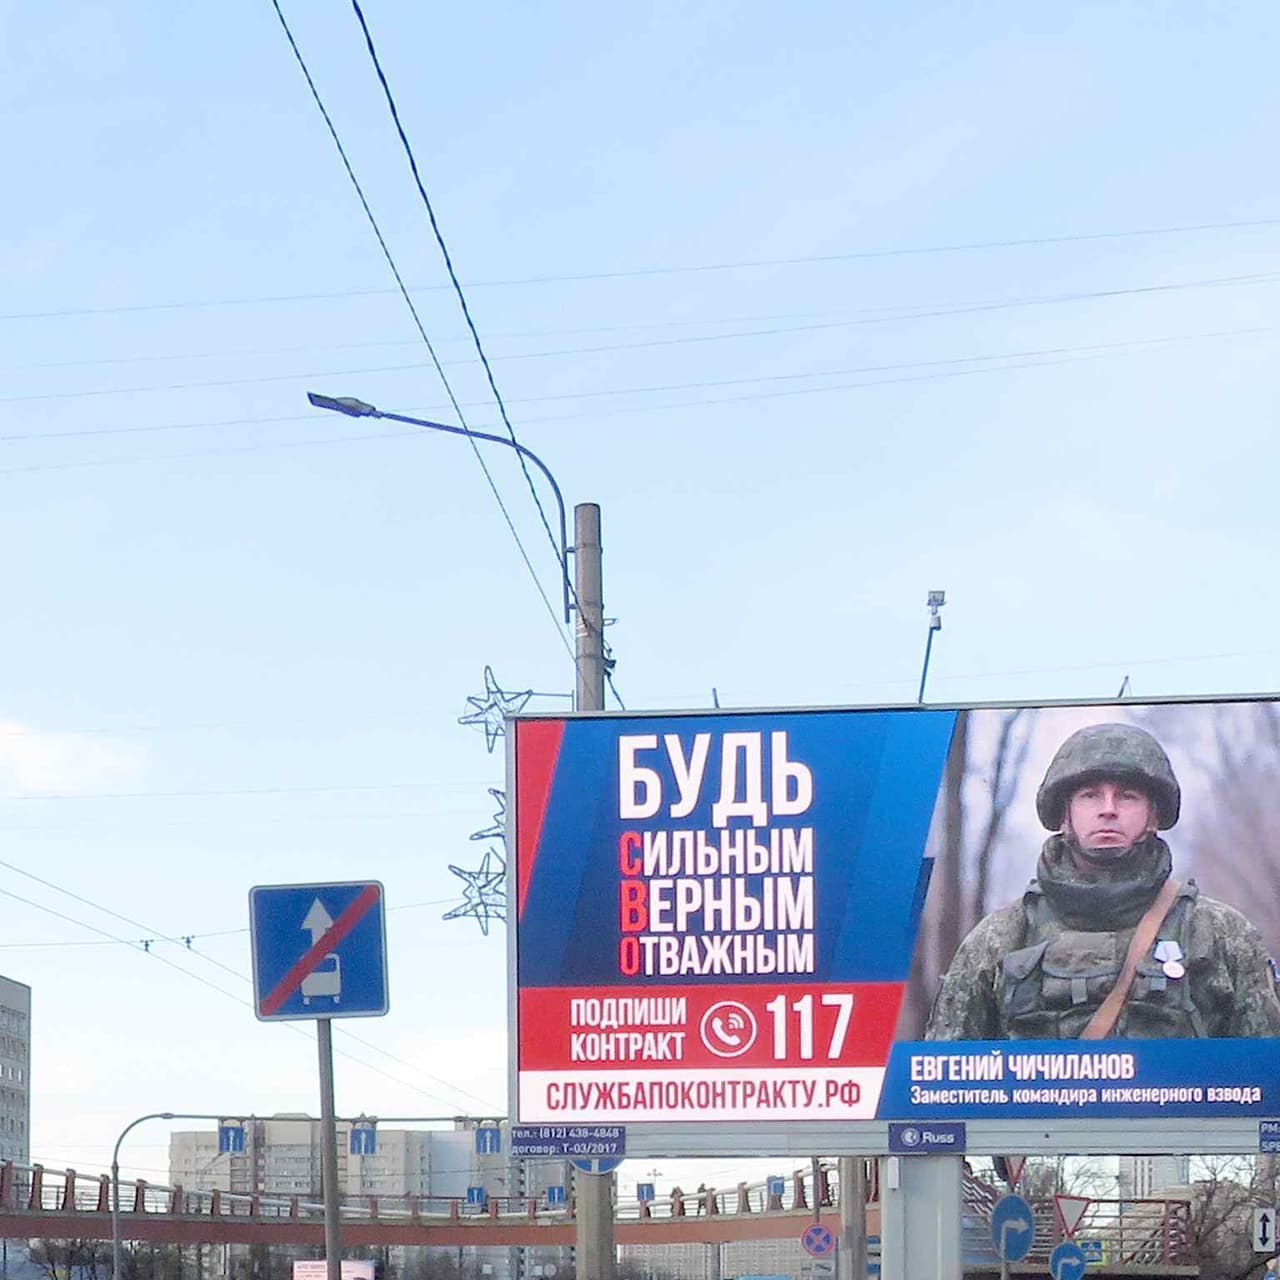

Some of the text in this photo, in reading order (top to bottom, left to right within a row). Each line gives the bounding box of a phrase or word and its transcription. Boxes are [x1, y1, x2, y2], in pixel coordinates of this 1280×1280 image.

[619, 731, 813, 828] БУДЬ
[620, 828, 813, 876] СИЛЬНЫМ
[621, 876, 814, 932] ВЕРНЫМ
[621, 934, 814, 975] ОТВАЖНЫМ
[572, 997, 687, 1028] ПОДПИШИ
[766, 994, 854, 1060] 117
[571, 1032, 686, 1061] КОНТРАКТ
[911, 1051, 1135, 1081] ЕВГЕНИЙ ЧИЧИЛАНОВ
[547, 1079, 861, 1111] СЛУЖБАПОКОНТРАКТУ.РФ
[910, 1085, 1262, 1106] Заместитель командира инженерного взвода
[540, 1128, 566, 1139] (812)
[569, 1128, 619, 1138] 438-4848
[922, 1131, 955, 1143] Russ
